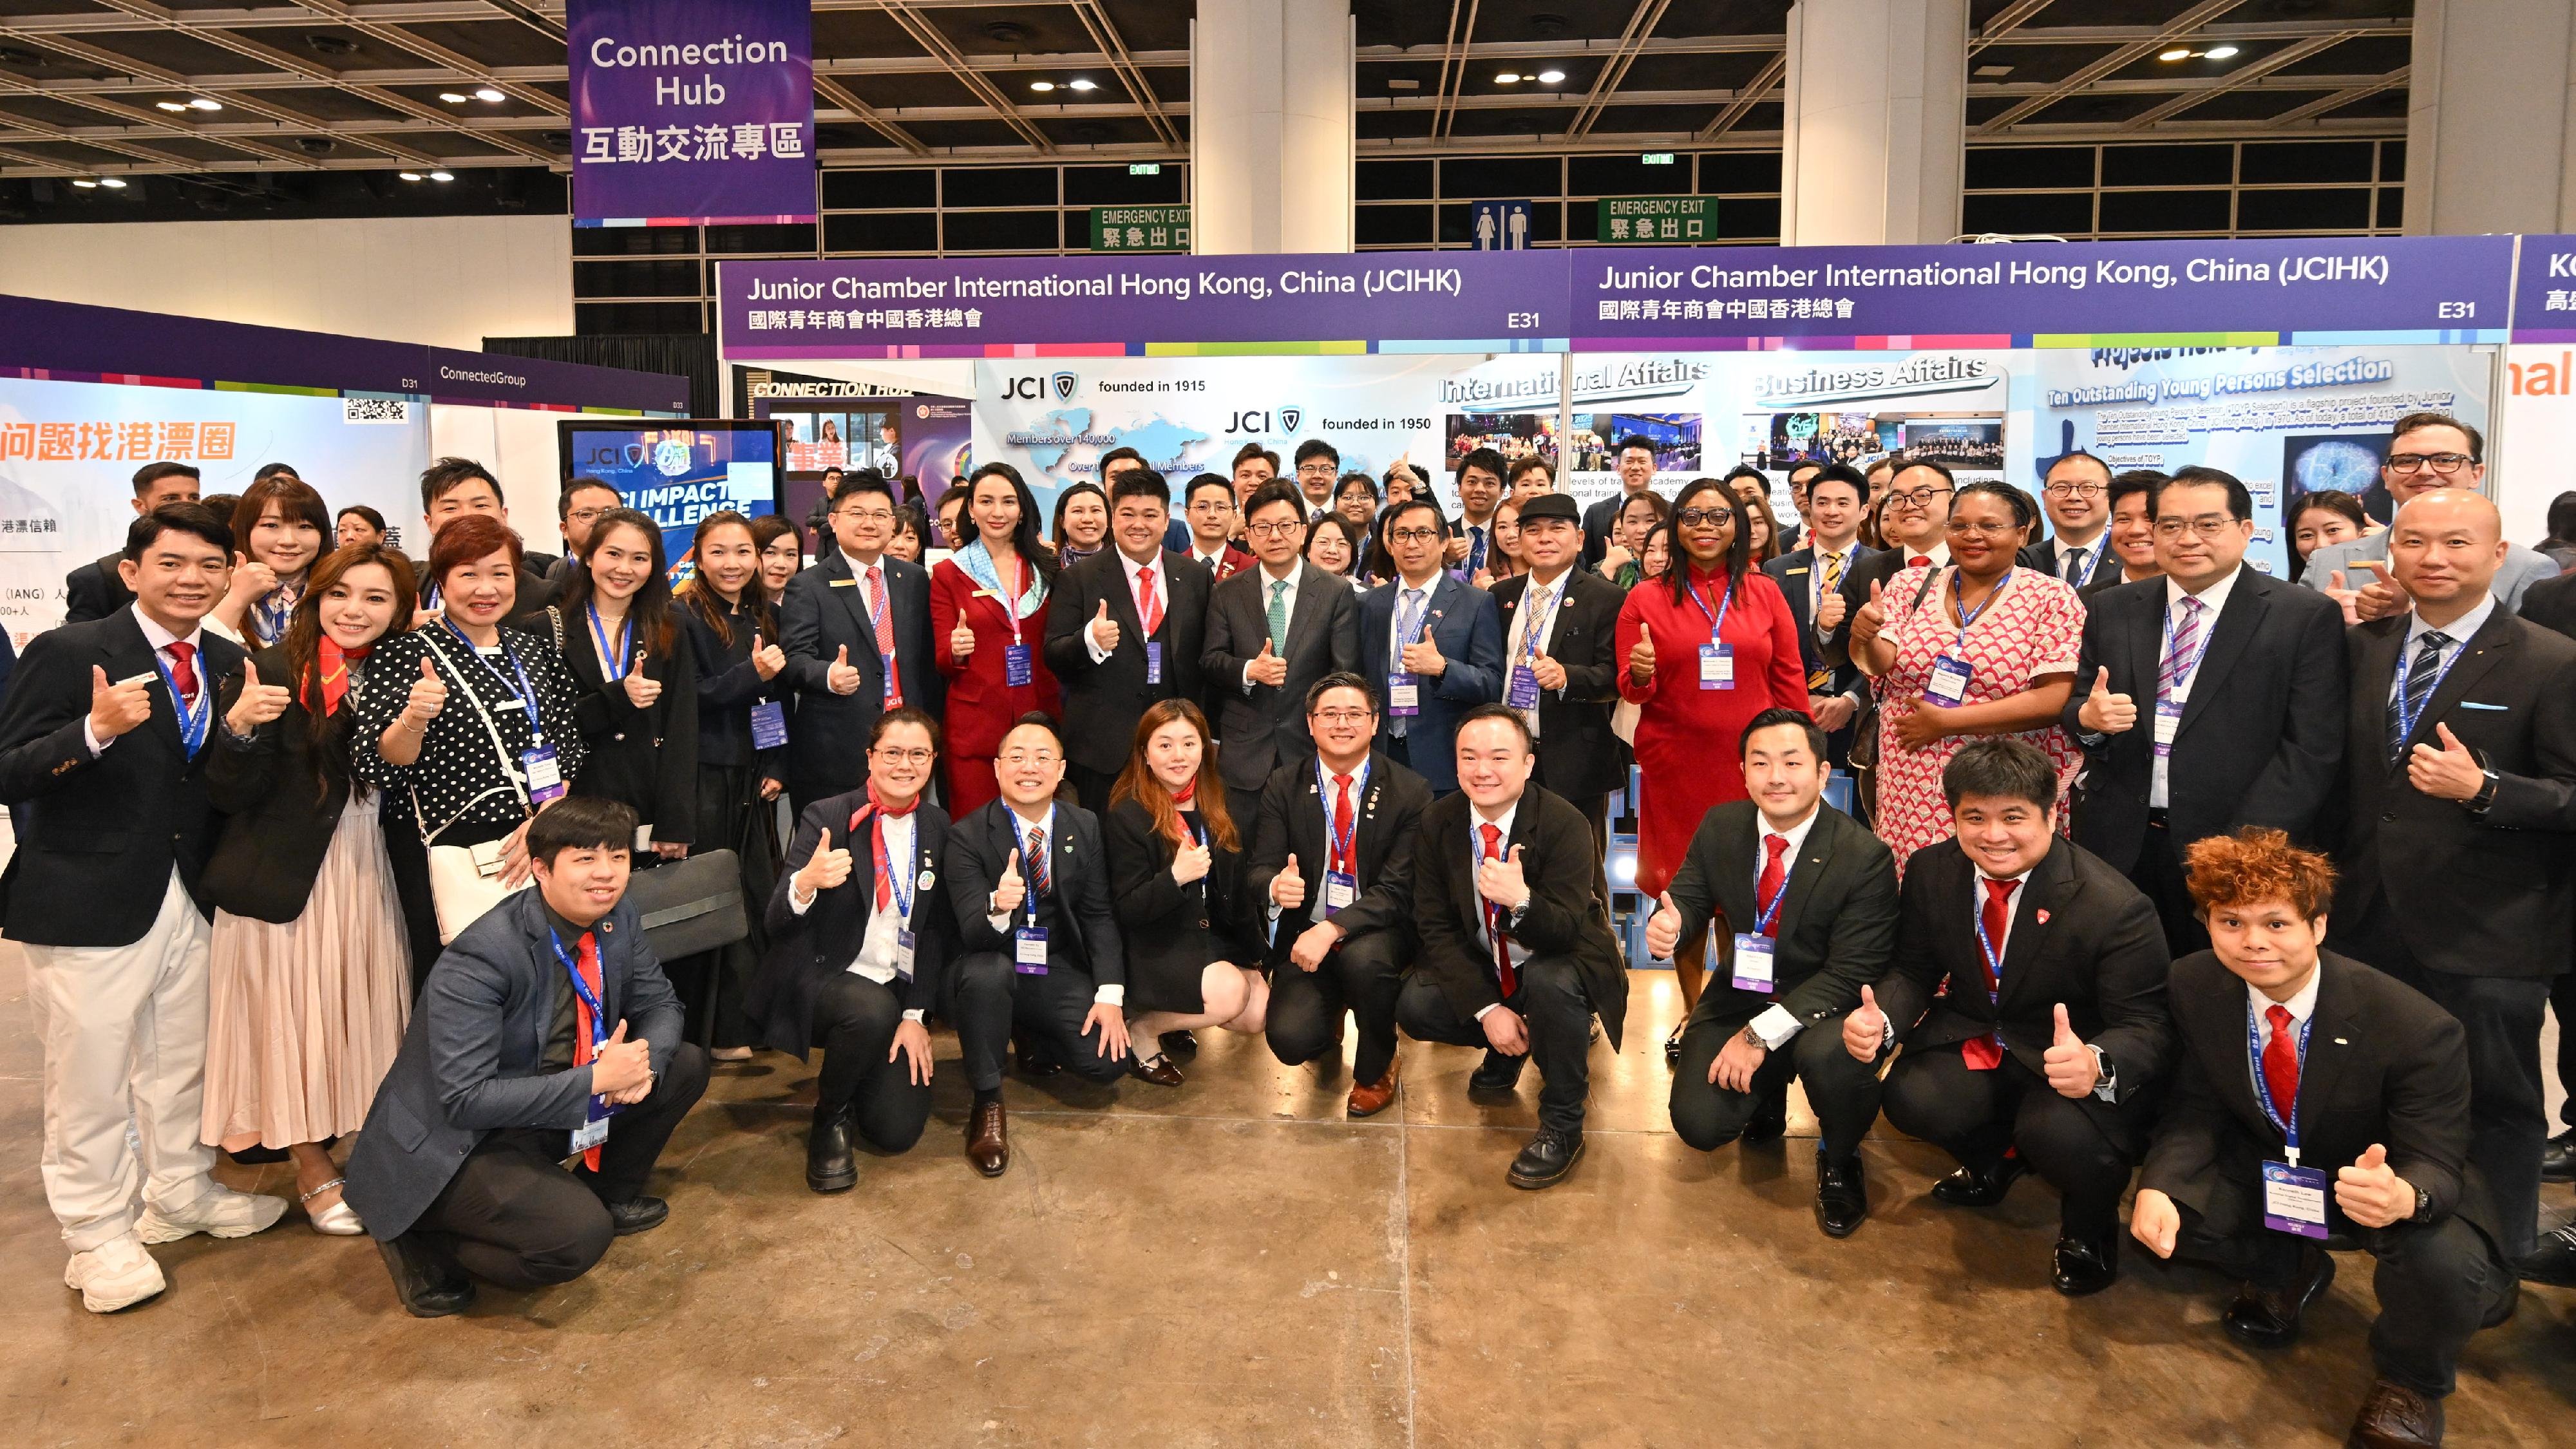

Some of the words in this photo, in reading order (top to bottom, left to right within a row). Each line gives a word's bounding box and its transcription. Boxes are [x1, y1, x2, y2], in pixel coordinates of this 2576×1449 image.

[591, 34, 787, 67] Connection
[656, 74, 726, 106] Hub
[580, 122, 806, 164] 互動交流專區
[1102, 210, 1166, 223] EMERGENCY
[1169, 209, 1191, 223] EXIT
[1611, 200, 1678, 214] EMERGENCY
[1681, 200, 1705, 213] EXIT
[1103, 227, 1189, 247] 緊急出口
[1611, 218, 1703, 239] 緊急出口
[1598, 266, 1683, 289] Junior
[1690, 264, 1817, 288] Chamber
[1826, 260, 2000, 287] International
[2010, 261, 2087, 289] Hong
[2096, 259, 2177, 288] Kong,
[2186, 257, 2270, 281] China
[2278, 255, 2389, 285] (JCIHK)
[2550, 253, 2576, 278] K
[747, 278, 825, 299] Junior
[832, 276, 947, 299] Chamber
[955, 273, 1112, 298] International
[1121, 273, 1191, 300] Hong
[1199, 272, 1273, 299] Kong,
[1280, 270, 1355, 293] China
[1363, 268, 1462, 298] (JCIHK)
[748, 308, 982, 330] 國際青年商會中國香港總會
[1598, 297, 1855, 320] 國際青年商會中國香港總會
[2439, 301, 2475, 318] E31
[1508, 313, 1540, 329] E31
[402, 379, 418, 389] D31
[440, 366, 526, 388] ConnectedGroup
[1439, 365, 1610, 402] Internatinal
[1620, 359, 1712, 387] Affairs
[1755, 367, 1883, 396] Business
[1891, 355, 1988, 383] Affairs
[2048, 390, 2069, 407] Ten
[2072, 381, 2157, 404] Outstanding
[2161, 377, 2211, 400] Young
[2214, 369, 2286, 394] Persons
[2287, 356, 2392, 388] Selection
[753, 382, 871, 397] CONNECTION
[1001, 377, 1045, 399] JCI
[1099, 381, 1153, 392] founded
[1159, 381, 1170, 392] in
[1175, 380, 1206, 392] 1915
[2118, 410, 2150, 420] Outstanding
[2151, 410, 2168, 419] Young
[2306, 399, 2336, 410] flagship
[2339, 397, 2367, 408] project
[2369, 395, 2404, 404] founded
[2407, 393, 2418, 404] by
[2422, 392, 2451, 402] Junior
[2349, 410, 2365, 420] total
[2378, 409, 2394, 419] 413
[1225, 411, 1269, 433] JCI
[1323, 419, 1378, 430] founded
[1383, 419, 1394, 429] in
[1400, 419, 1431, 430] 1950
[0, 422, 236, 460] 问题找港漂圈
[1007, 434, 1052, 444] Members
[1078, 434, 1115, 445] 140,000
[586, 448, 619, 465] JCI
[790, 442, 847, 471] 事業
[1069, 462, 1092, 471] Over
[1157, 461, 1204, 471] Members
[1865, 454, 1879, 464] JCI
[2108, 455, 2136, 464] Objectives
[640, 481, 730, 509] IMPACT
[2255, 481, 2273, 489] excel
[2259, 495, 2272, 503] and
[887, 698, 897, 706] JCI
[183, 728, 194, 744] Global
